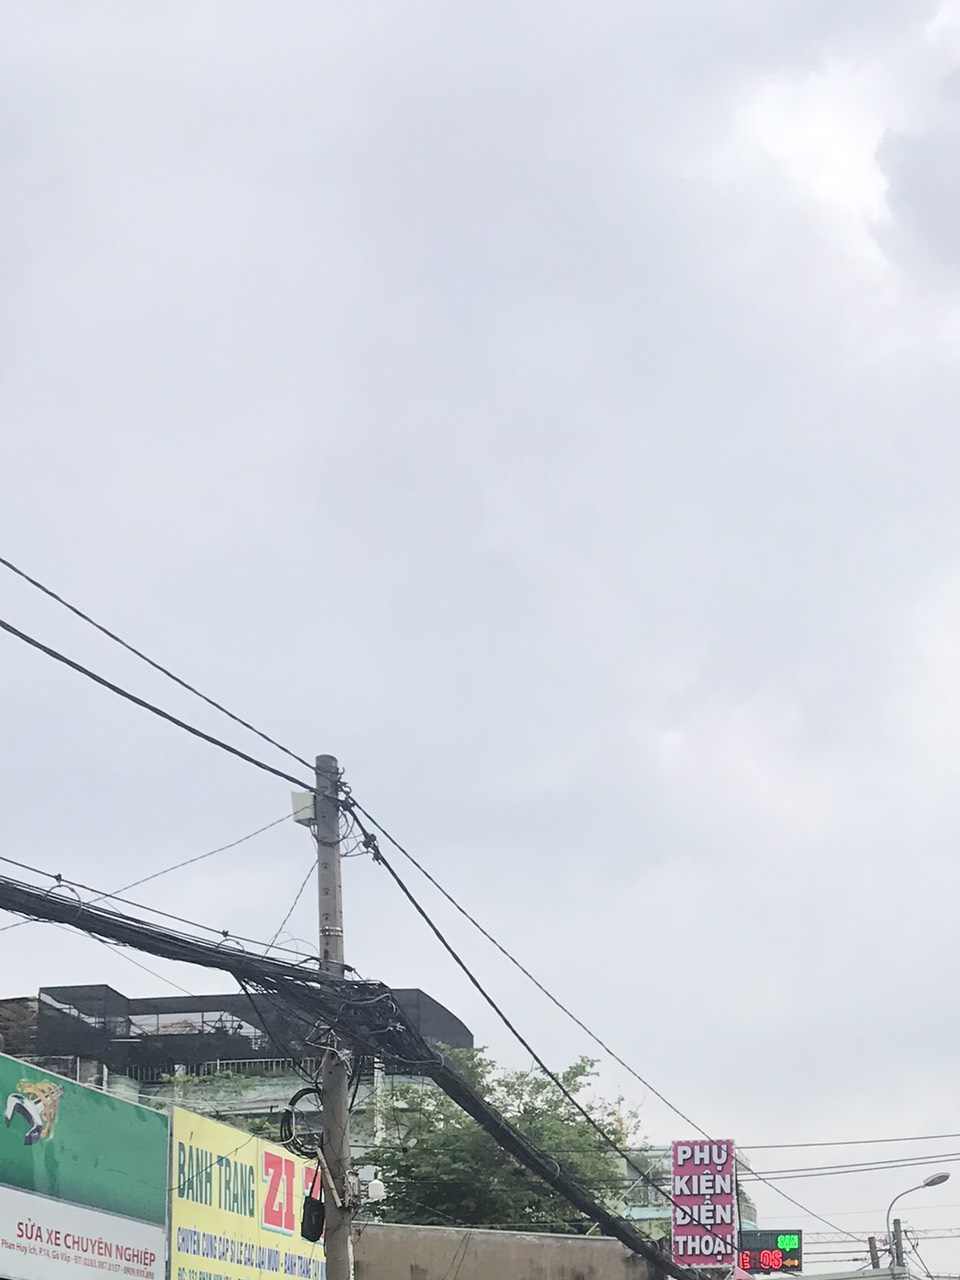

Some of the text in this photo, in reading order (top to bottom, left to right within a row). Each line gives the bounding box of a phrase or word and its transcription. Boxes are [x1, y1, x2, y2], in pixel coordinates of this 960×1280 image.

[677, 1144, 728, 1170] PHỤ
[178, 1131, 213, 1206] BÁNH
[217, 1148, 254, 1218] TRÁNG
[263, 1151, 295, 1232] ZI
[674, 1170, 731, 1199] KIỆN
[675, 1200, 731, 1231] ĐIỆN
[17, 1218, 156, 1270] SỬA XE CHUYÊN NGHIỆP
[674, 1234, 732, 1260] THOẠI
